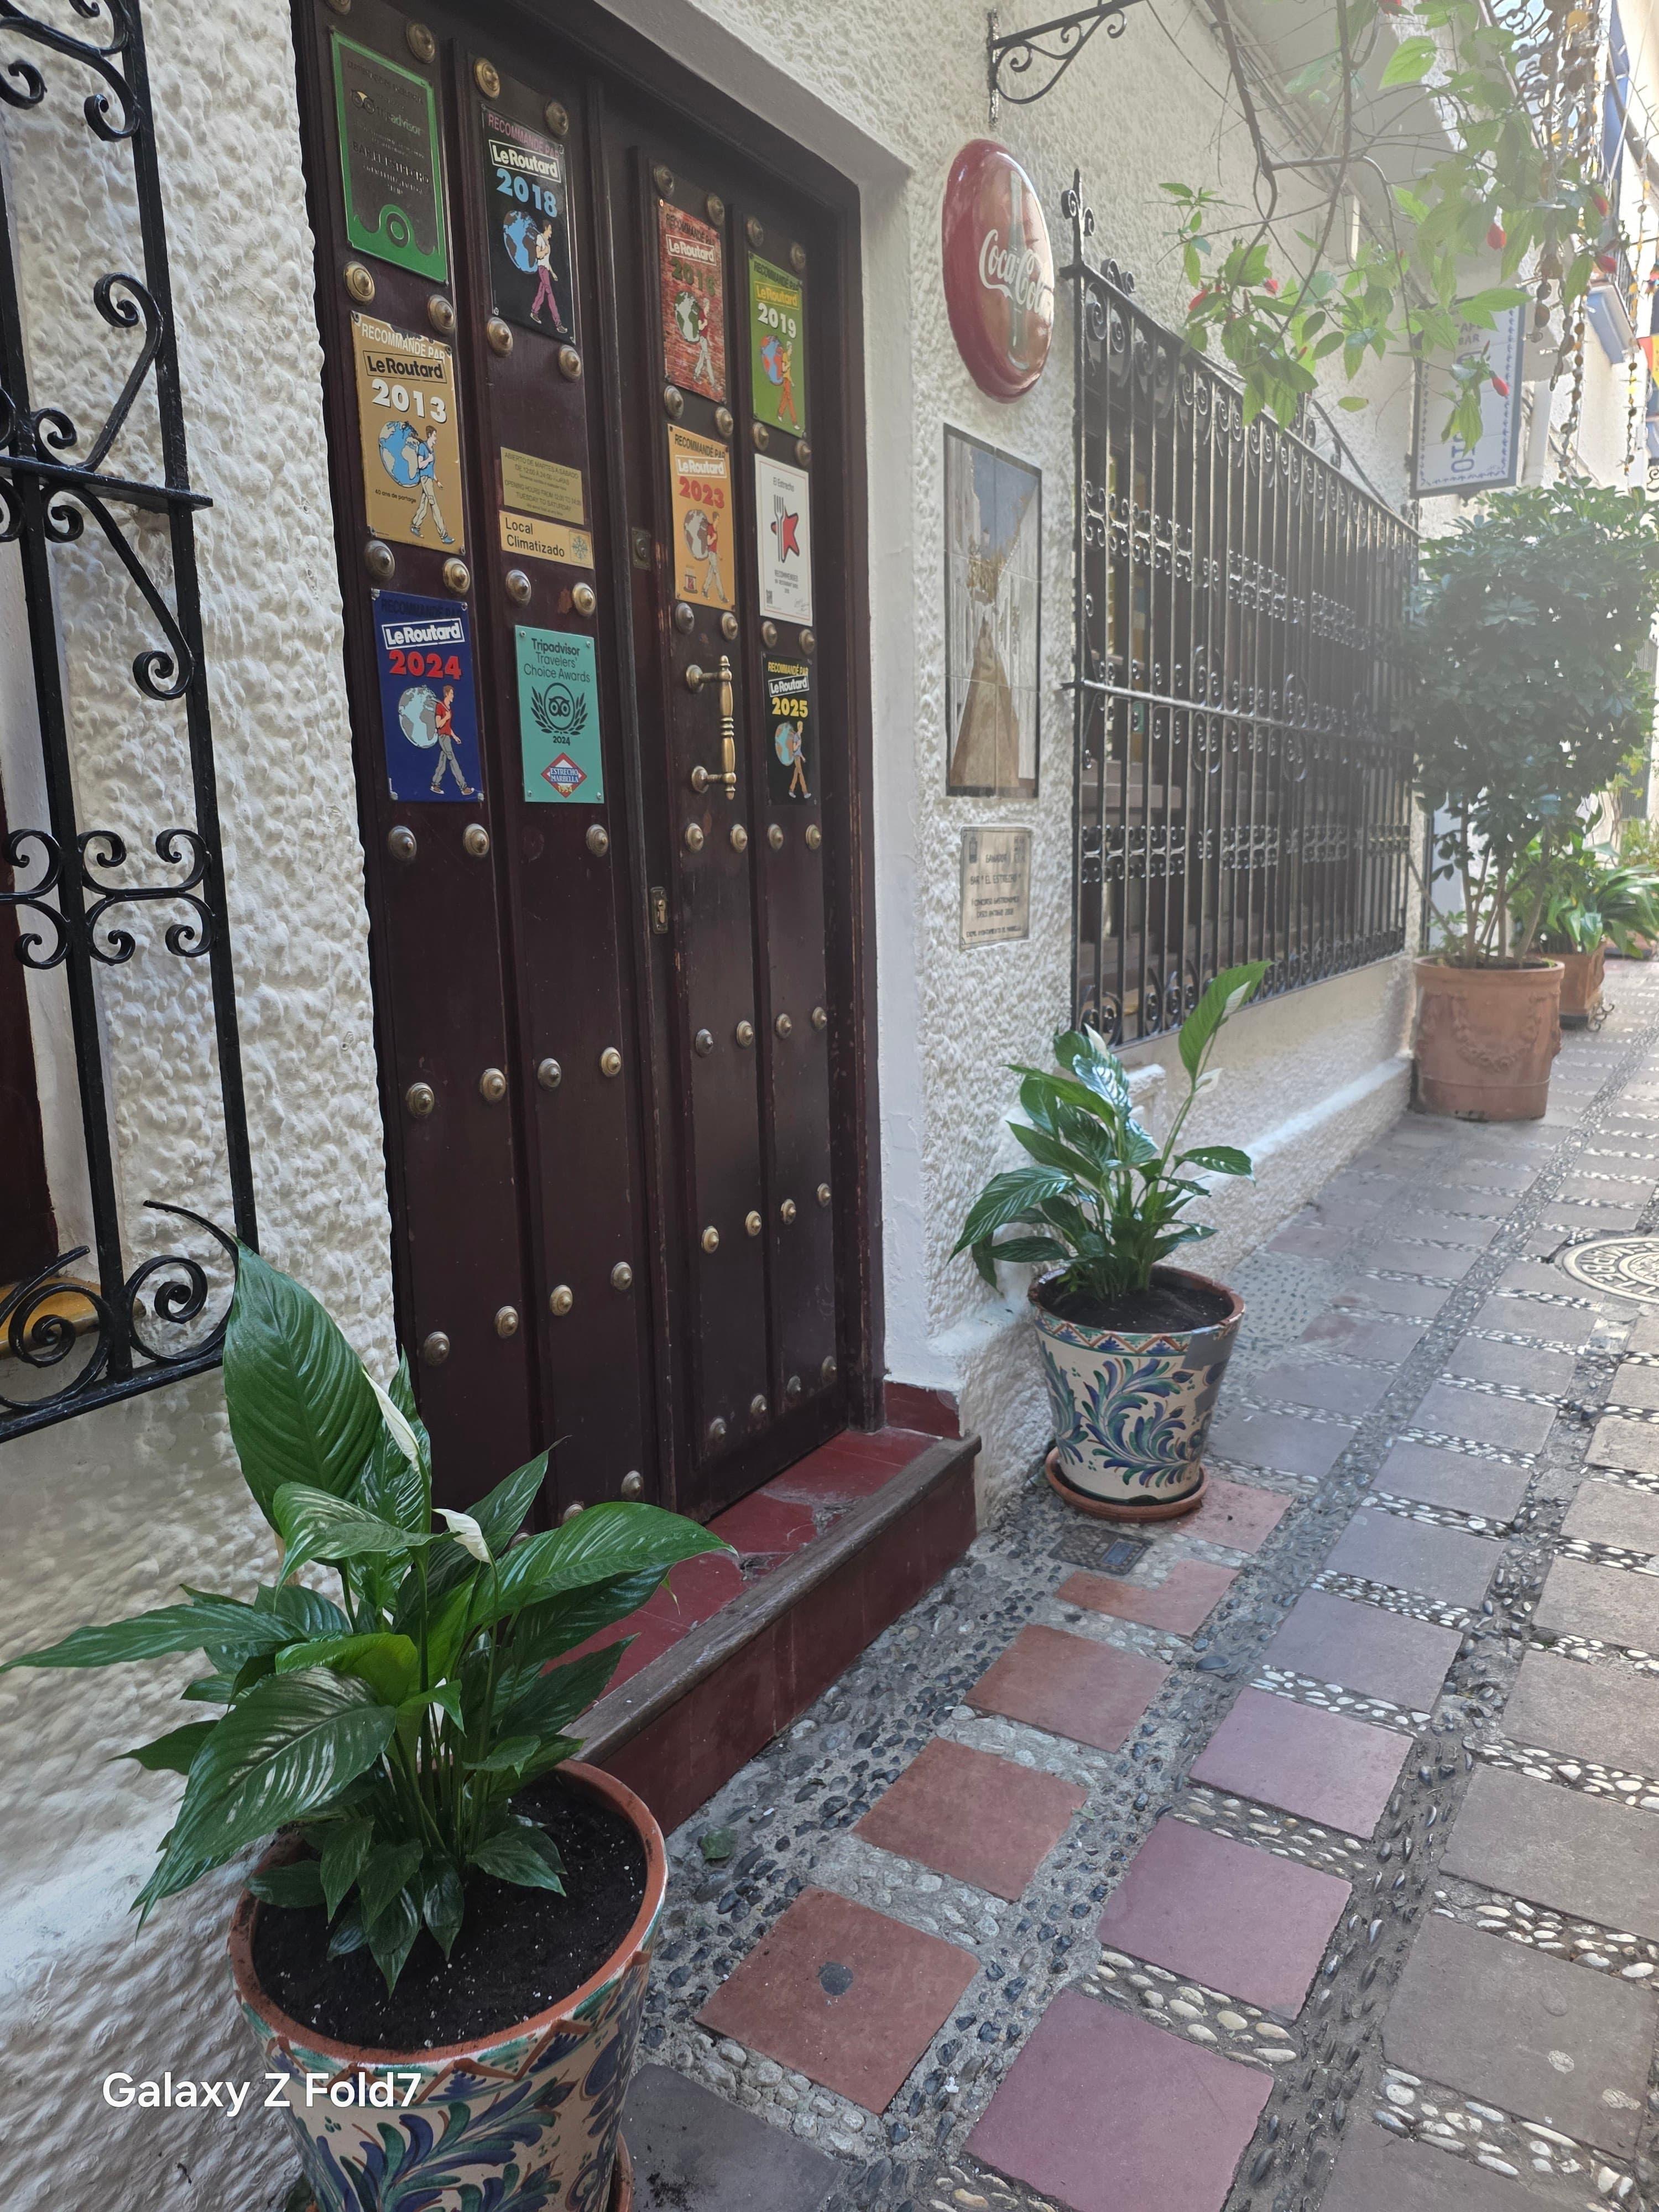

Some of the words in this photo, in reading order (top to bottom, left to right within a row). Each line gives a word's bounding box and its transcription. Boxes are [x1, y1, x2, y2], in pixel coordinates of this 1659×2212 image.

[545, 145, 559, 158] PAR
[496, 168, 557, 217] 2018
[758, 302, 796, 338] 2019
[428, 346, 446, 362] PAR
[372, 378, 447, 423] 2013
[679, 476, 725, 509] 2023
[505, 517, 533, 535] Local
[507, 534, 565, 557] Climatizado
[531, 638, 580, 656] Tripadvisor
[389, 649, 462, 680] 2024
[524, 663, 556, 679] Choice
[558, 668, 591, 683] Awards
[772, 697, 808, 718] 2025
[553, 735, 571, 745] 2024
[550, 768, 579, 776] ESTRECHO
[550, 775, 579, 783] MARBELLA
